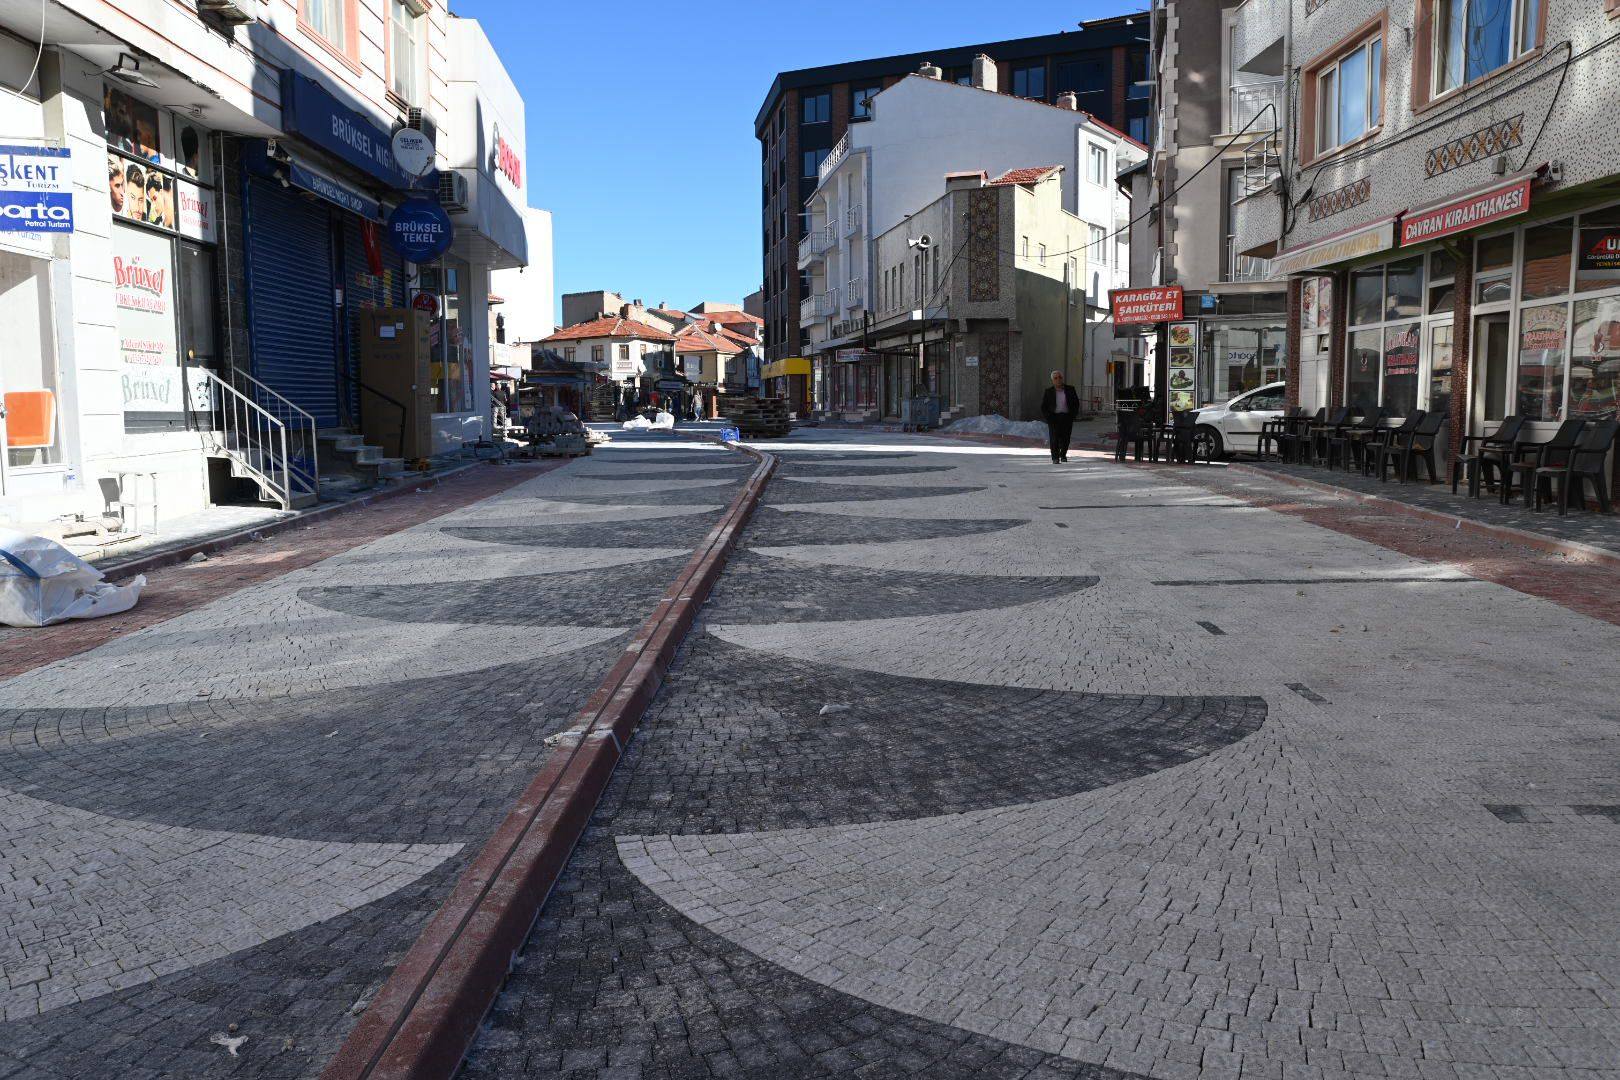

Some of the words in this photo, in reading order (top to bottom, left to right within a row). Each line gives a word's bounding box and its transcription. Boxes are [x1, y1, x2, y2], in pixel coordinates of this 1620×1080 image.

[332, 114, 373, 159] BRÜKSEL
[0, 203, 70, 220] arta
[1405, 215, 1443, 241] DAVRAN
[1444, 187, 1525, 230] KIRAATHANESİ
[25, 220, 46, 228] Petrol
[47, 220, 71, 228] Turizm
[395, 220, 444, 233] BRÜKSEL
[402, 232, 436, 243] TEKEL
[1115, 290, 1163, 304] KARAGÖZ
[1165, 290, 1179, 299] ET
[1119, 301, 1177, 317] ŞARKÜTERİ
